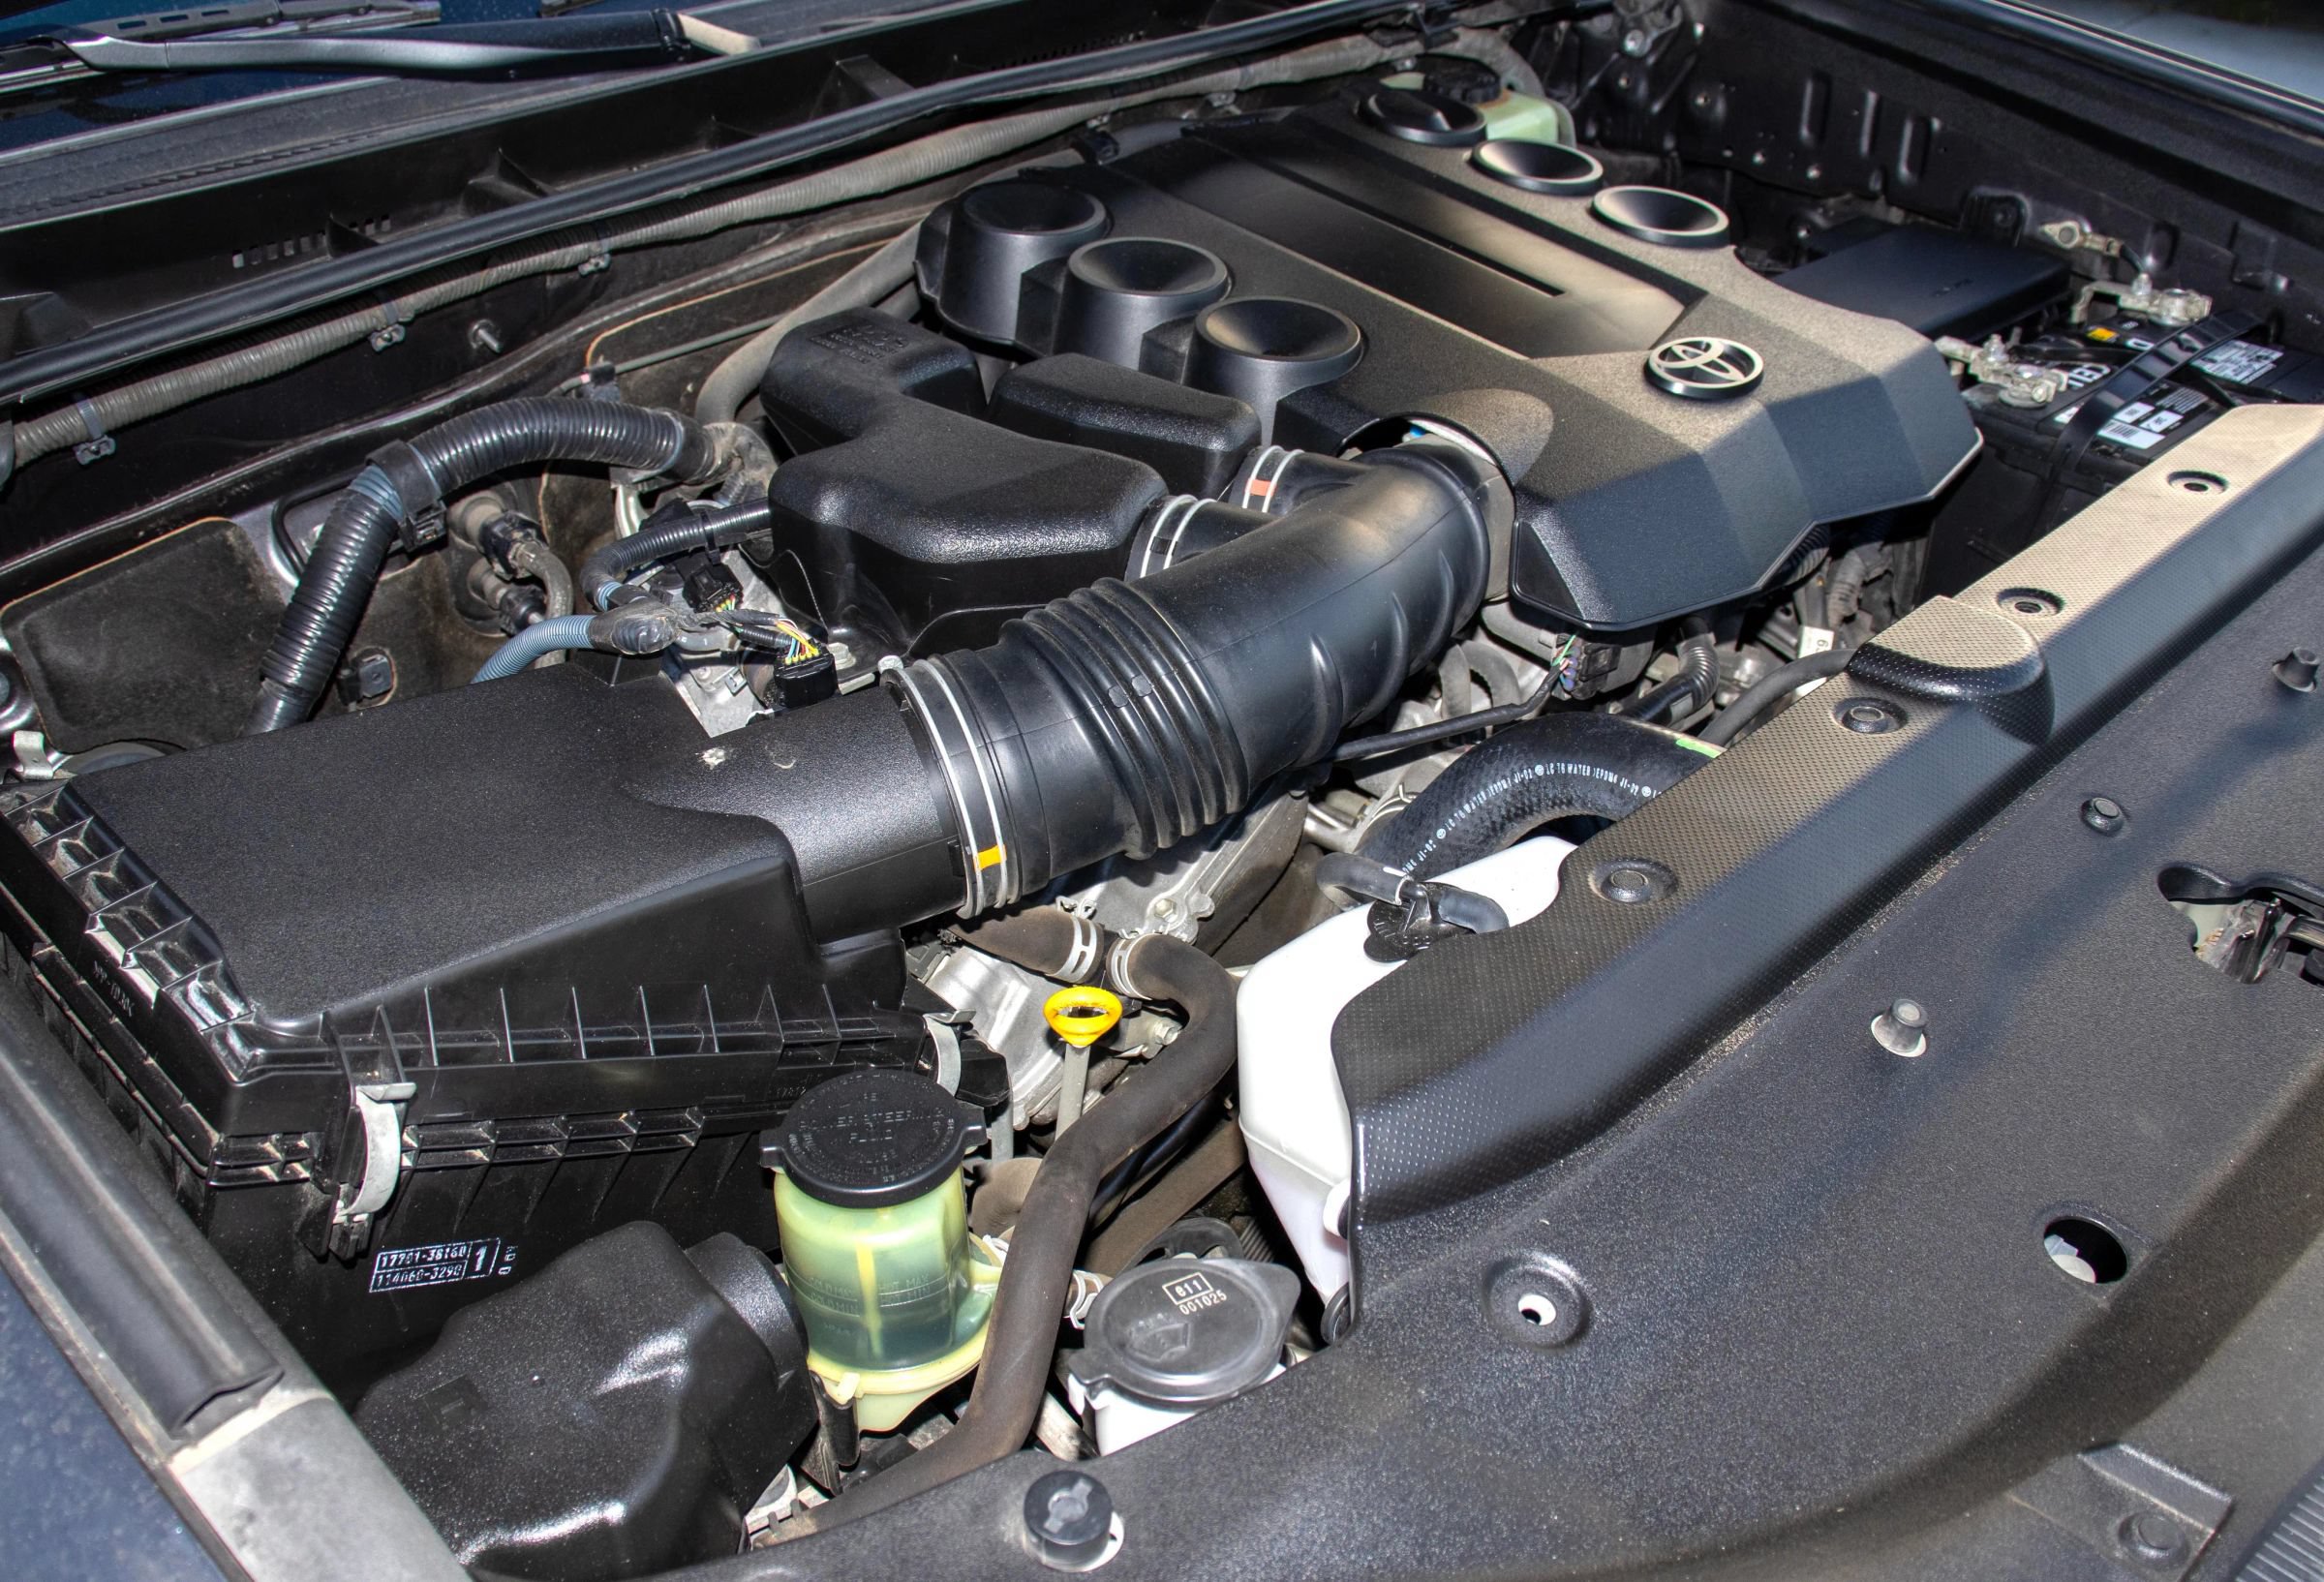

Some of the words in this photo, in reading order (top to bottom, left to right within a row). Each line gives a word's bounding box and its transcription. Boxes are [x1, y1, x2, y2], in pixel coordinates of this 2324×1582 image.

[1463, 791, 1486, 813] WATER
[1567, 763, 1591, 776] WATER
[474, 1245, 487, 1272] 1
[1175, 1279, 1202, 1297] e11
[1178, 1290, 1227, 1315] 001025
